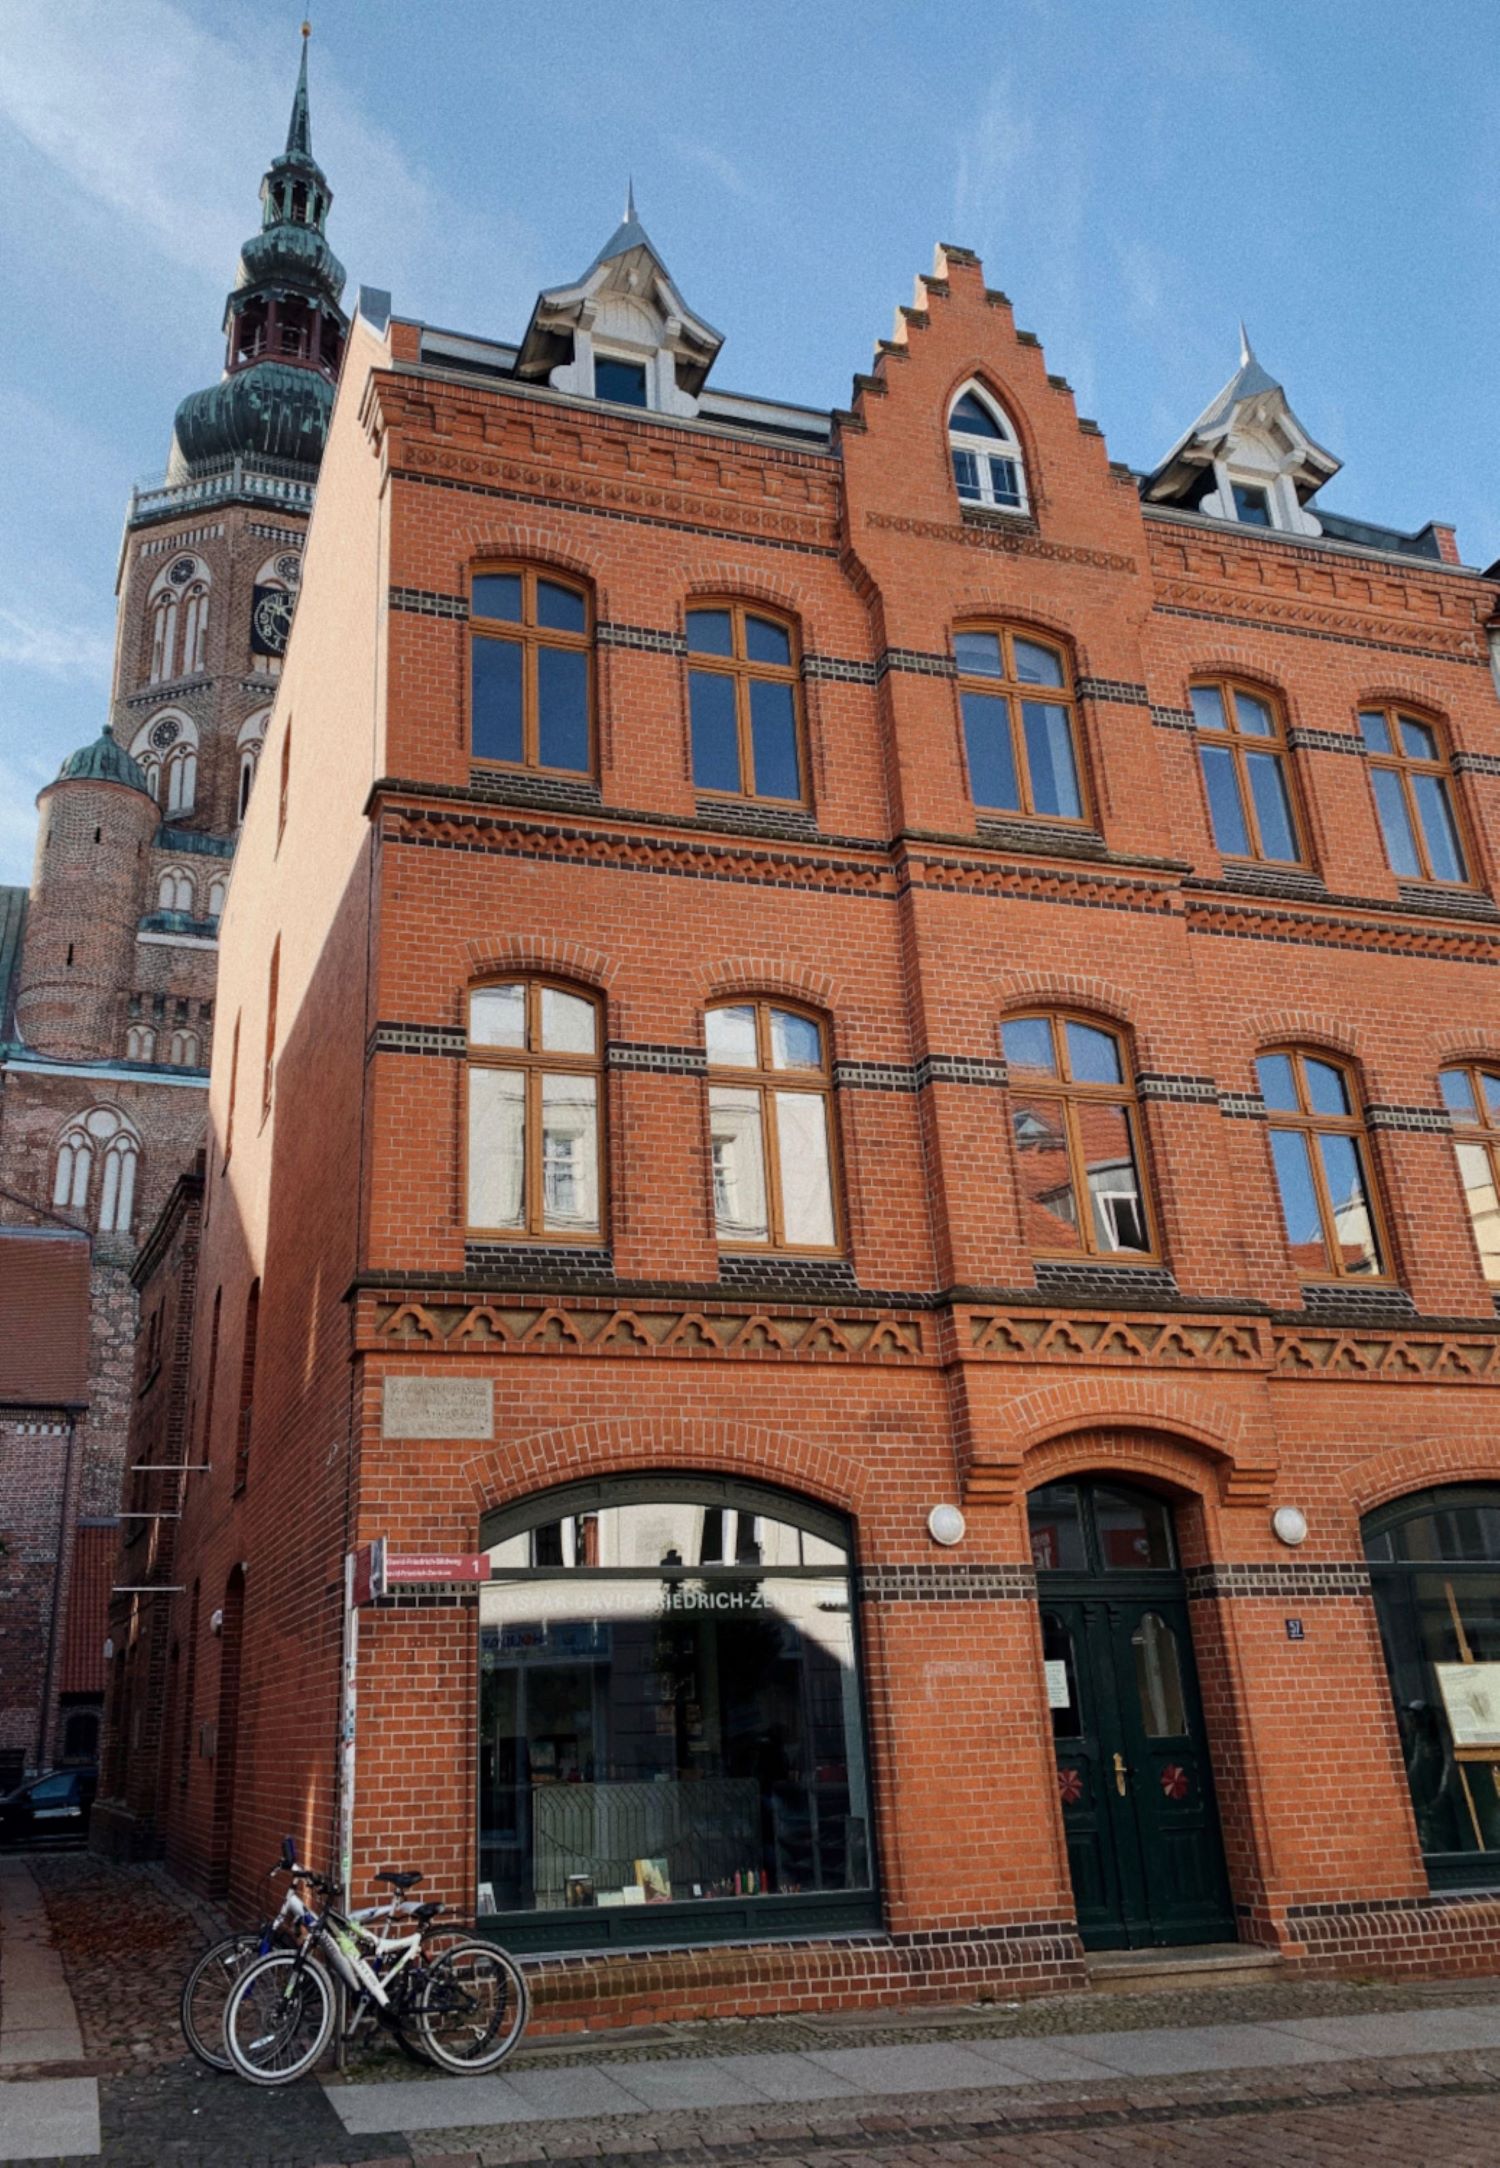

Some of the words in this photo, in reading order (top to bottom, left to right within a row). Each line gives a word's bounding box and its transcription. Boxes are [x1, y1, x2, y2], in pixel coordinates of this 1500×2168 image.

[260, 612, 269, 624] 9
[263, 624, 272, 637] 8
[472, 1560, 479, 1574] 1
